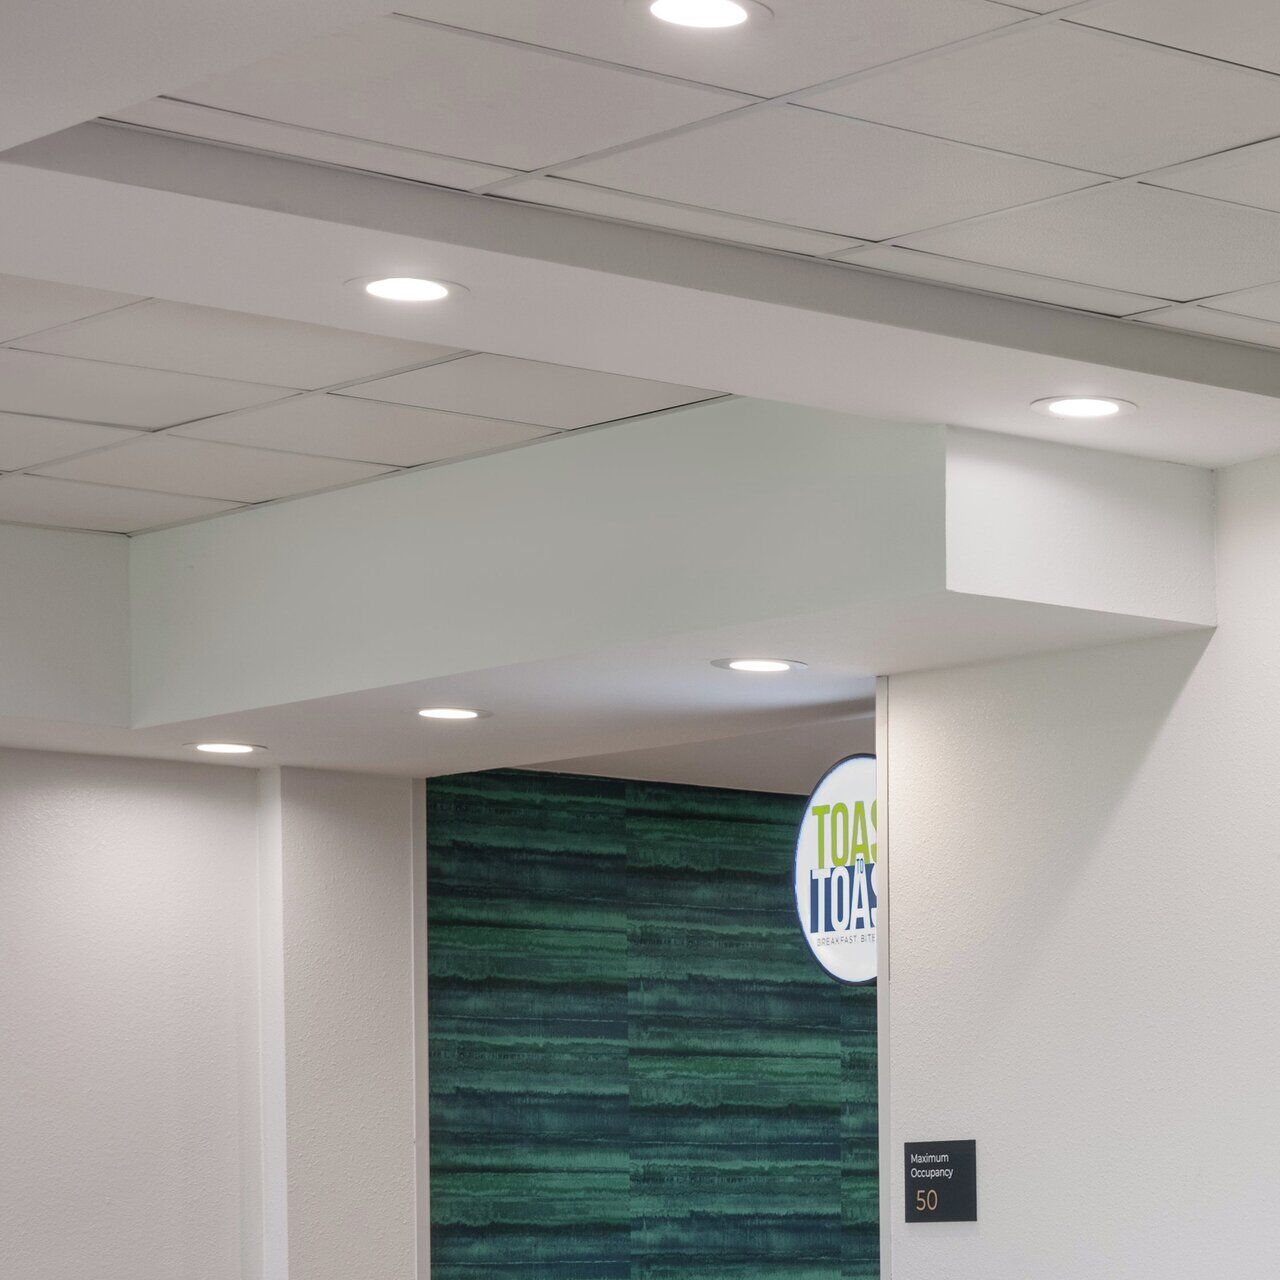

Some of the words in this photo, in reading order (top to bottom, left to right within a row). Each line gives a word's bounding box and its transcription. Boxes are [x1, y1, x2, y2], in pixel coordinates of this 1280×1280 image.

[817, 935, 857, 947] BREAKFAST
[910, 1153, 949, 1163] Maximum
[910, 1168, 954, 1179] Occupancy
[916, 1189, 938, 1211] 50
